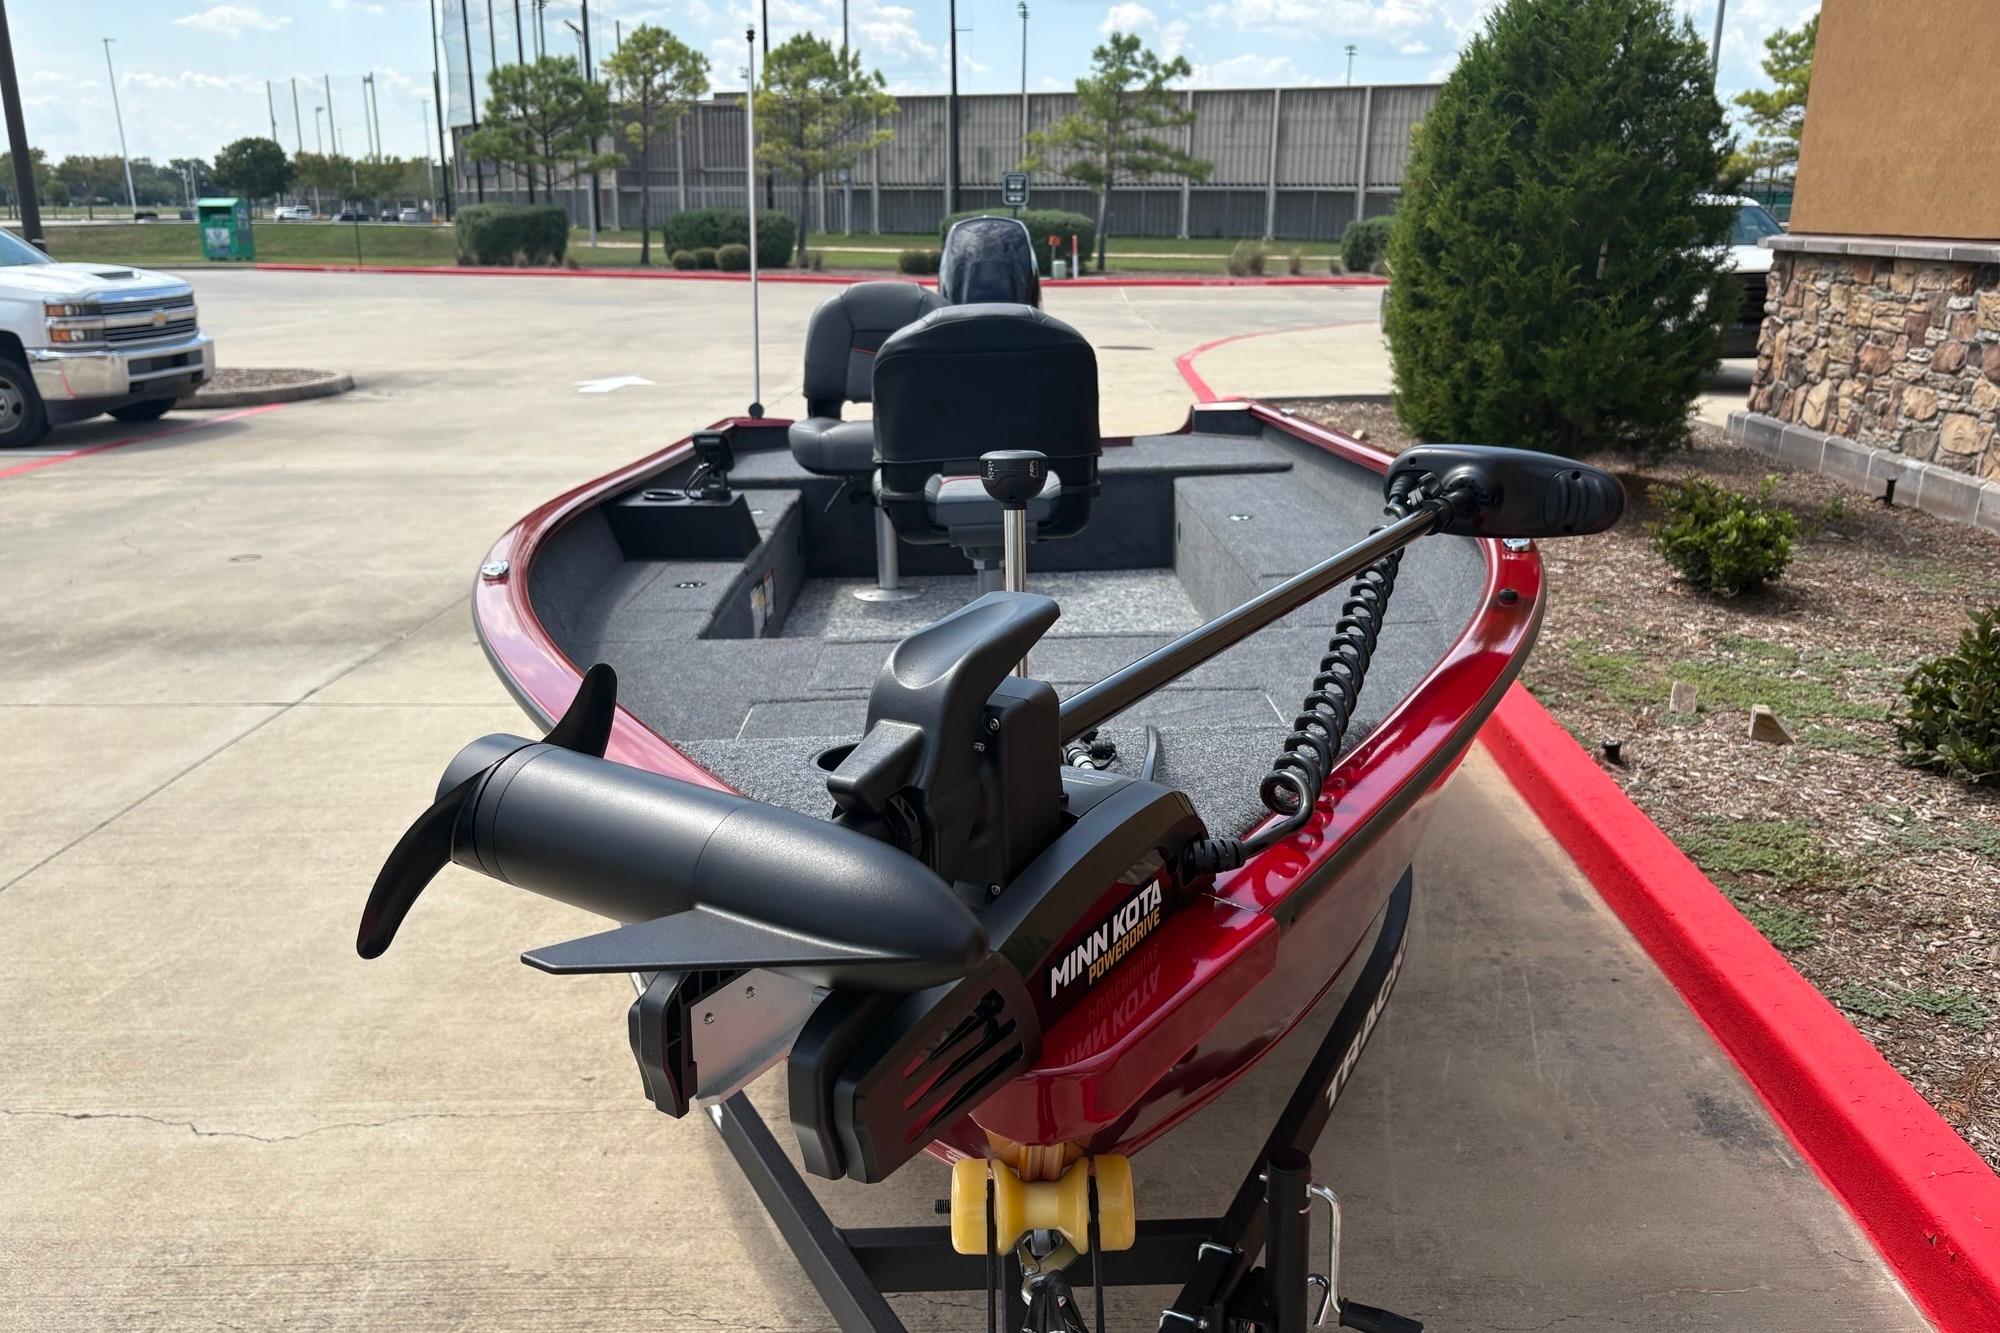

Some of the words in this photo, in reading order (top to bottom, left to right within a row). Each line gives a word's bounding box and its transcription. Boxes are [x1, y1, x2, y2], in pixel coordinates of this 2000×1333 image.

[1051, 922, 1108, 999] MINN
[1113, 879, 1162, 943] KOTA
[1088, 906, 1161, 986] POWERDRIVE
